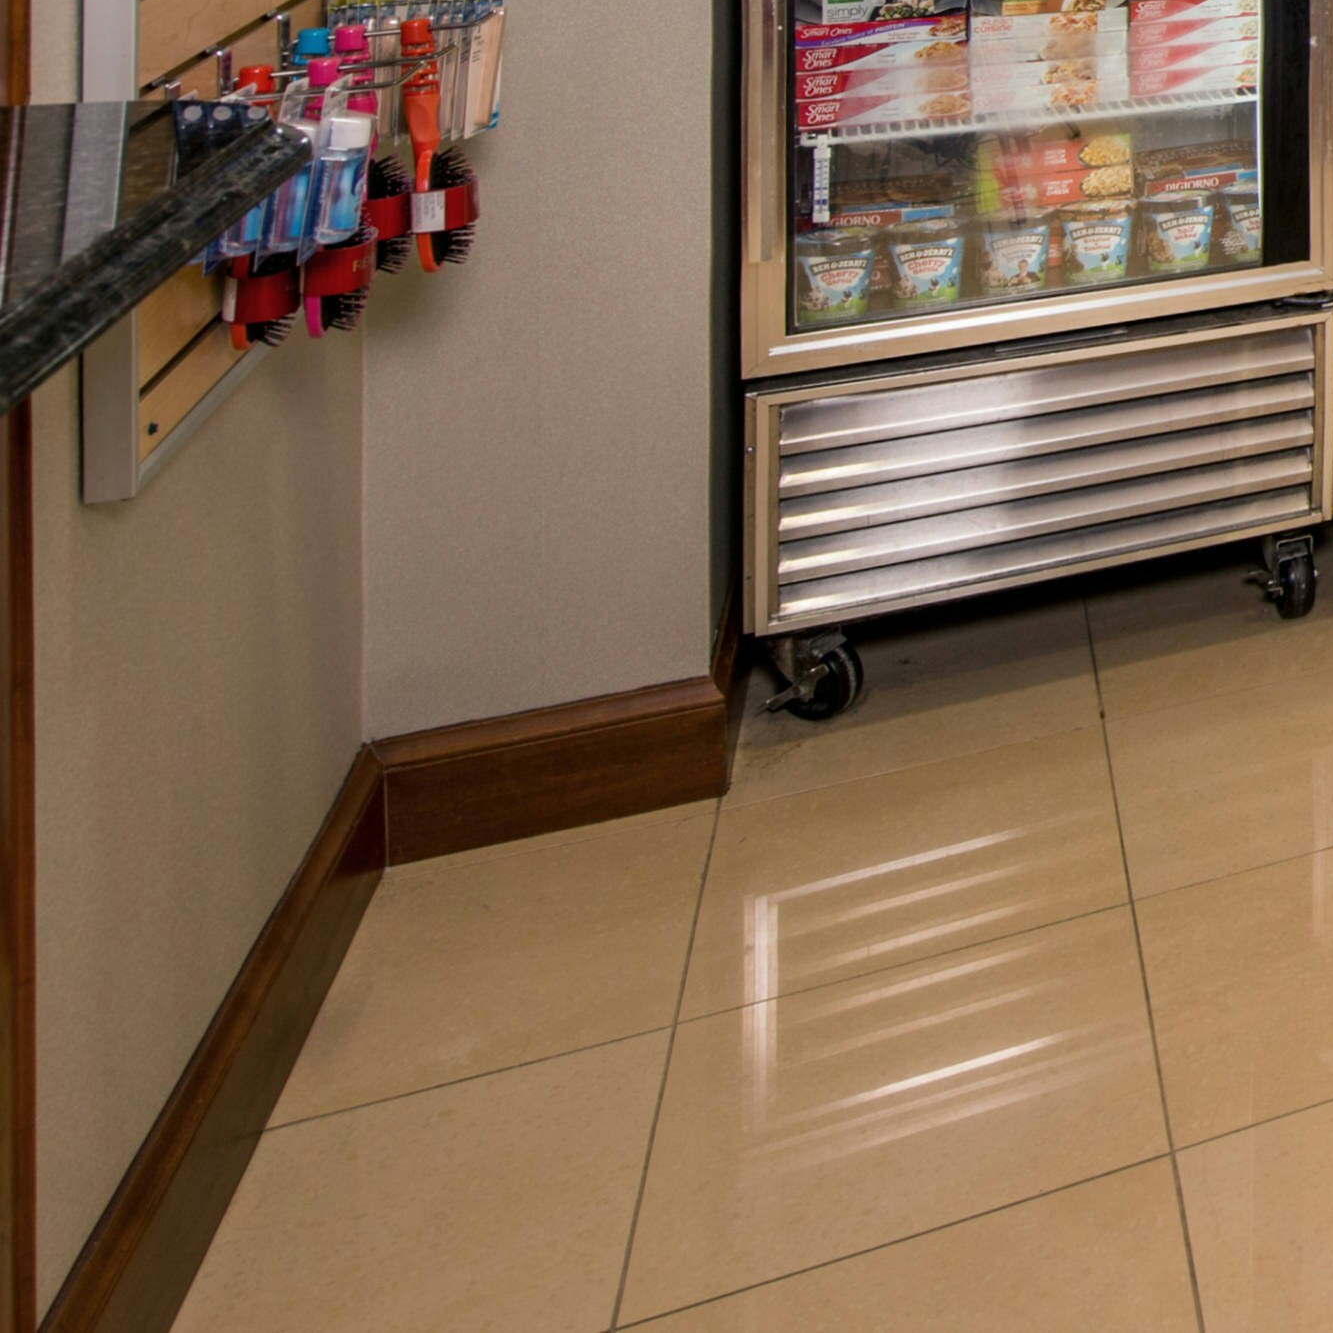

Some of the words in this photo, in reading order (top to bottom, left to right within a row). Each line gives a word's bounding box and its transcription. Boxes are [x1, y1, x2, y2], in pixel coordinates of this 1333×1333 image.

[826, 4, 868, 20] simply
[802, 27, 829, 38] Smart
[831, 26, 853, 37] Ones
[805, 48, 837, 62] Smart
[805, 59, 832, 69] Ones
[805, 74, 838, 88] Smart
[805, 84, 833, 96] Ones
[807, 103, 840, 116] Smart
[807, 112, 834, 124] Ones
[906, 259, 945, 270] Cherry
[821, 269, 857, 282] Cherry
